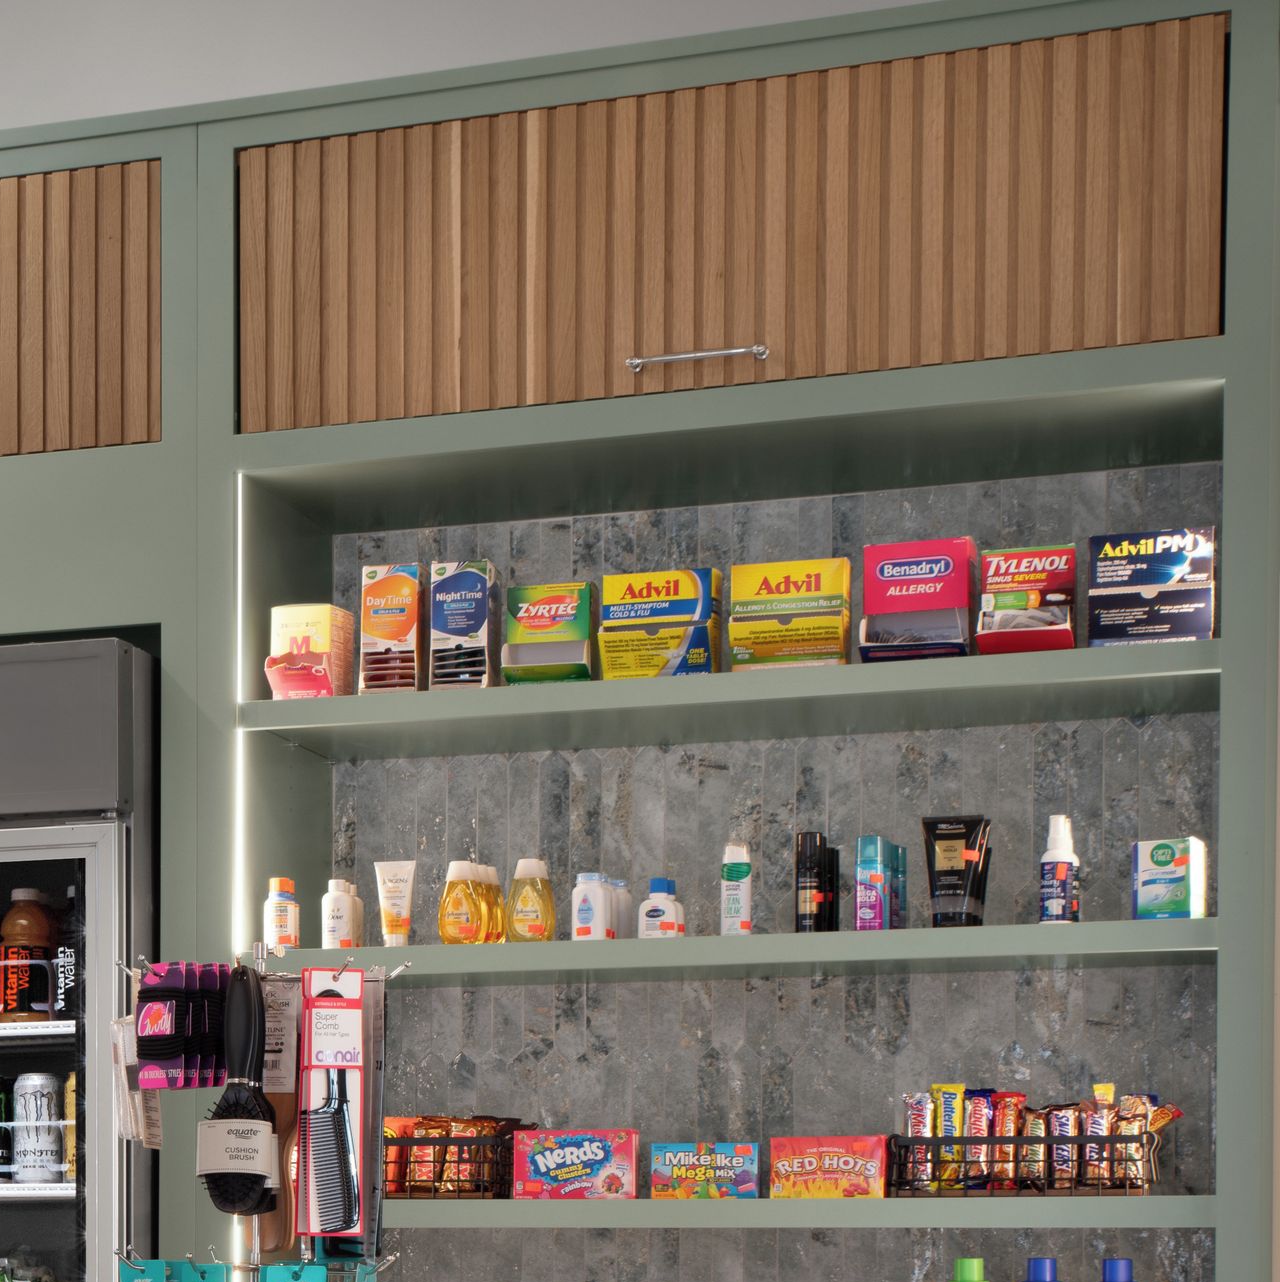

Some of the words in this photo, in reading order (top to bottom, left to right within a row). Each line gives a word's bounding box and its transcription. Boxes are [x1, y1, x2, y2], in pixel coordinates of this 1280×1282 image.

[1098, 537, 1155, 558] Advil
[1155, 533, 1194, 554] PM
[883, 560, 946, 578] Benadryl
[986, 554, 1068, 575] TYLENOL
[755, 573, 821, 595] Advil
[986, 575, 1012, 583] SINUS
[1013, 572, 1048, 582] SEVERE
[436, 590, 483, 602] NightTime
[620, 579, 680, 600] Advil
[887, 582, 944, 596] ALLERGY
[517, 602, 579, 617] ZYRTEC
[609, 602, 670, 612] MULTI-SYMPTOM
[735, 603, 765, 612] ALLERGY
[772, 600, 817, 609] CONGESTION
[18, 945, 30, 989] water
[7, 946, 18, 1010] vitamin
[315, 1012, 338, 1022] Super
[315, 1022, 339, 1030] Comb
[315, 1047, 360, 1063] conair
[227, 1128, 259, 1137] equate
[229, 1153, 255, 1161] BRUSH
[664, 1152, 711, 1166] Mike
[716, 1153, 744, 1167] Ike
[549, 1163, 583, 1177] Gummy
[672, 1165, 714, 1180] Mega
[775, 1157, 818, 1176] RED
[821, 1155, 879, 1177] HOTS
[558, 1167, 592, 1180] Clusters
[561, 1181, 594, 1195] rainbow
